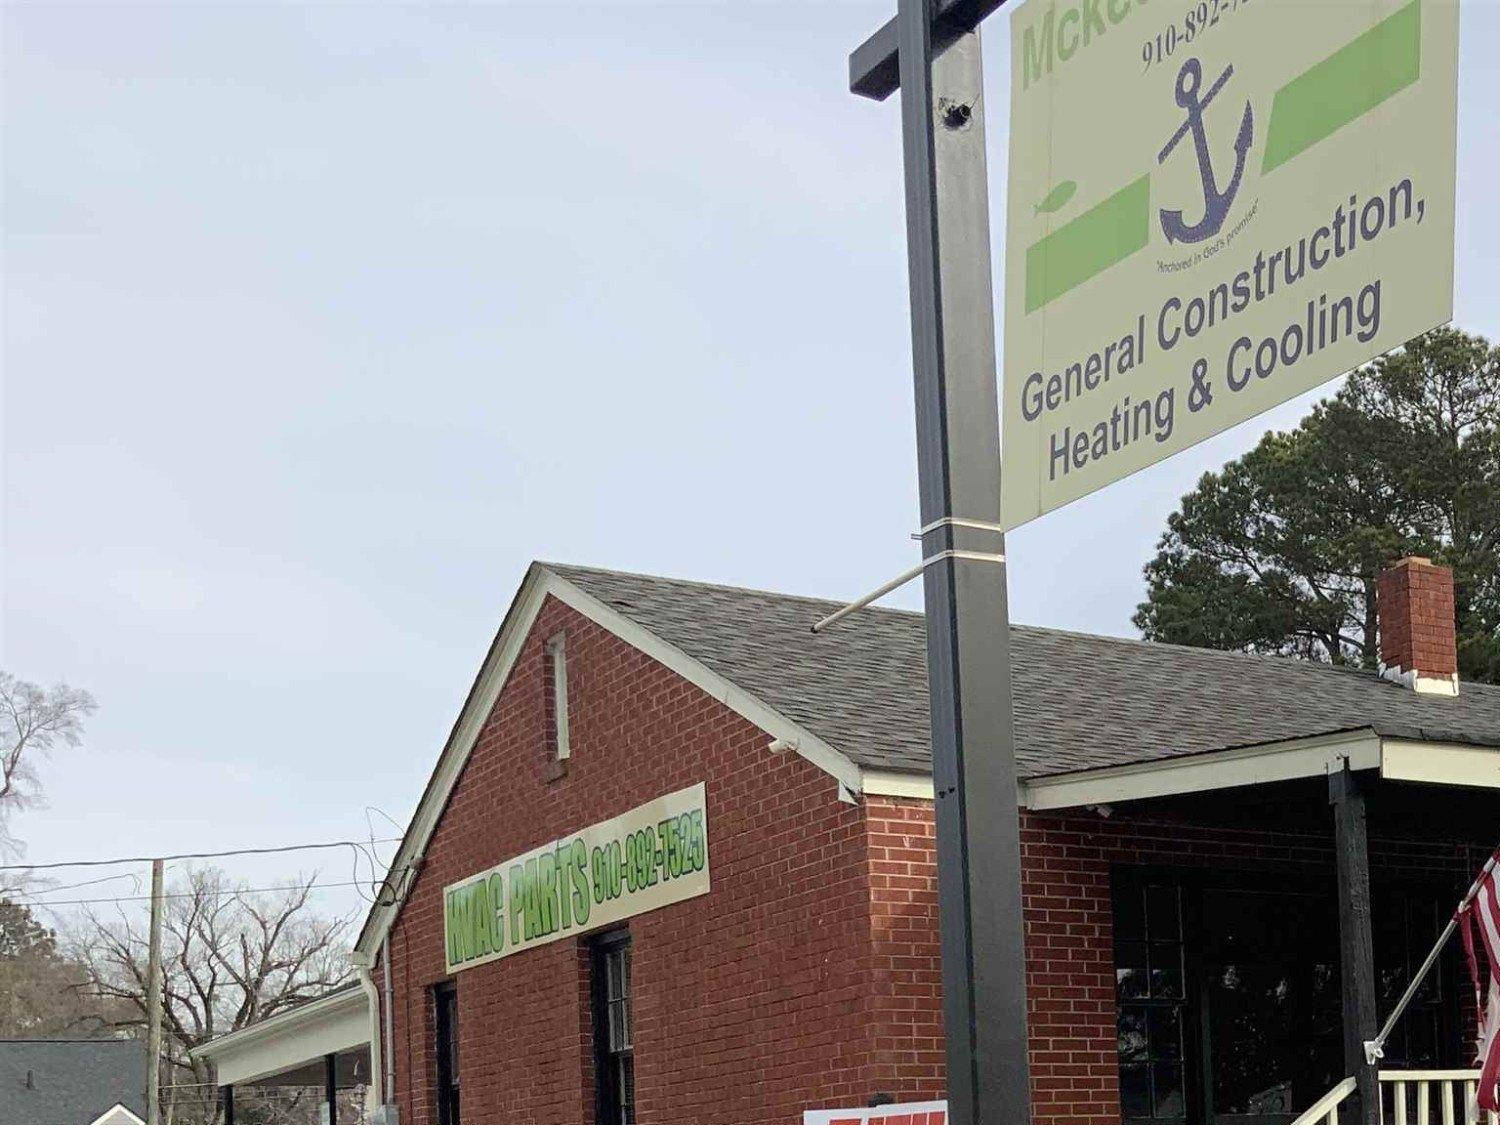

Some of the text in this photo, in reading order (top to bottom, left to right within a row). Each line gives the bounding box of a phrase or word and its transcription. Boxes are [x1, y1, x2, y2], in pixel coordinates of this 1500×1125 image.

[1021, 177, 1426, 422] General Construction,
[1048, 279, 1381, 481] Heating & Cooling
[447, 872, 504, 965] HVAC
[509, 837, 591, 946] PARTS
